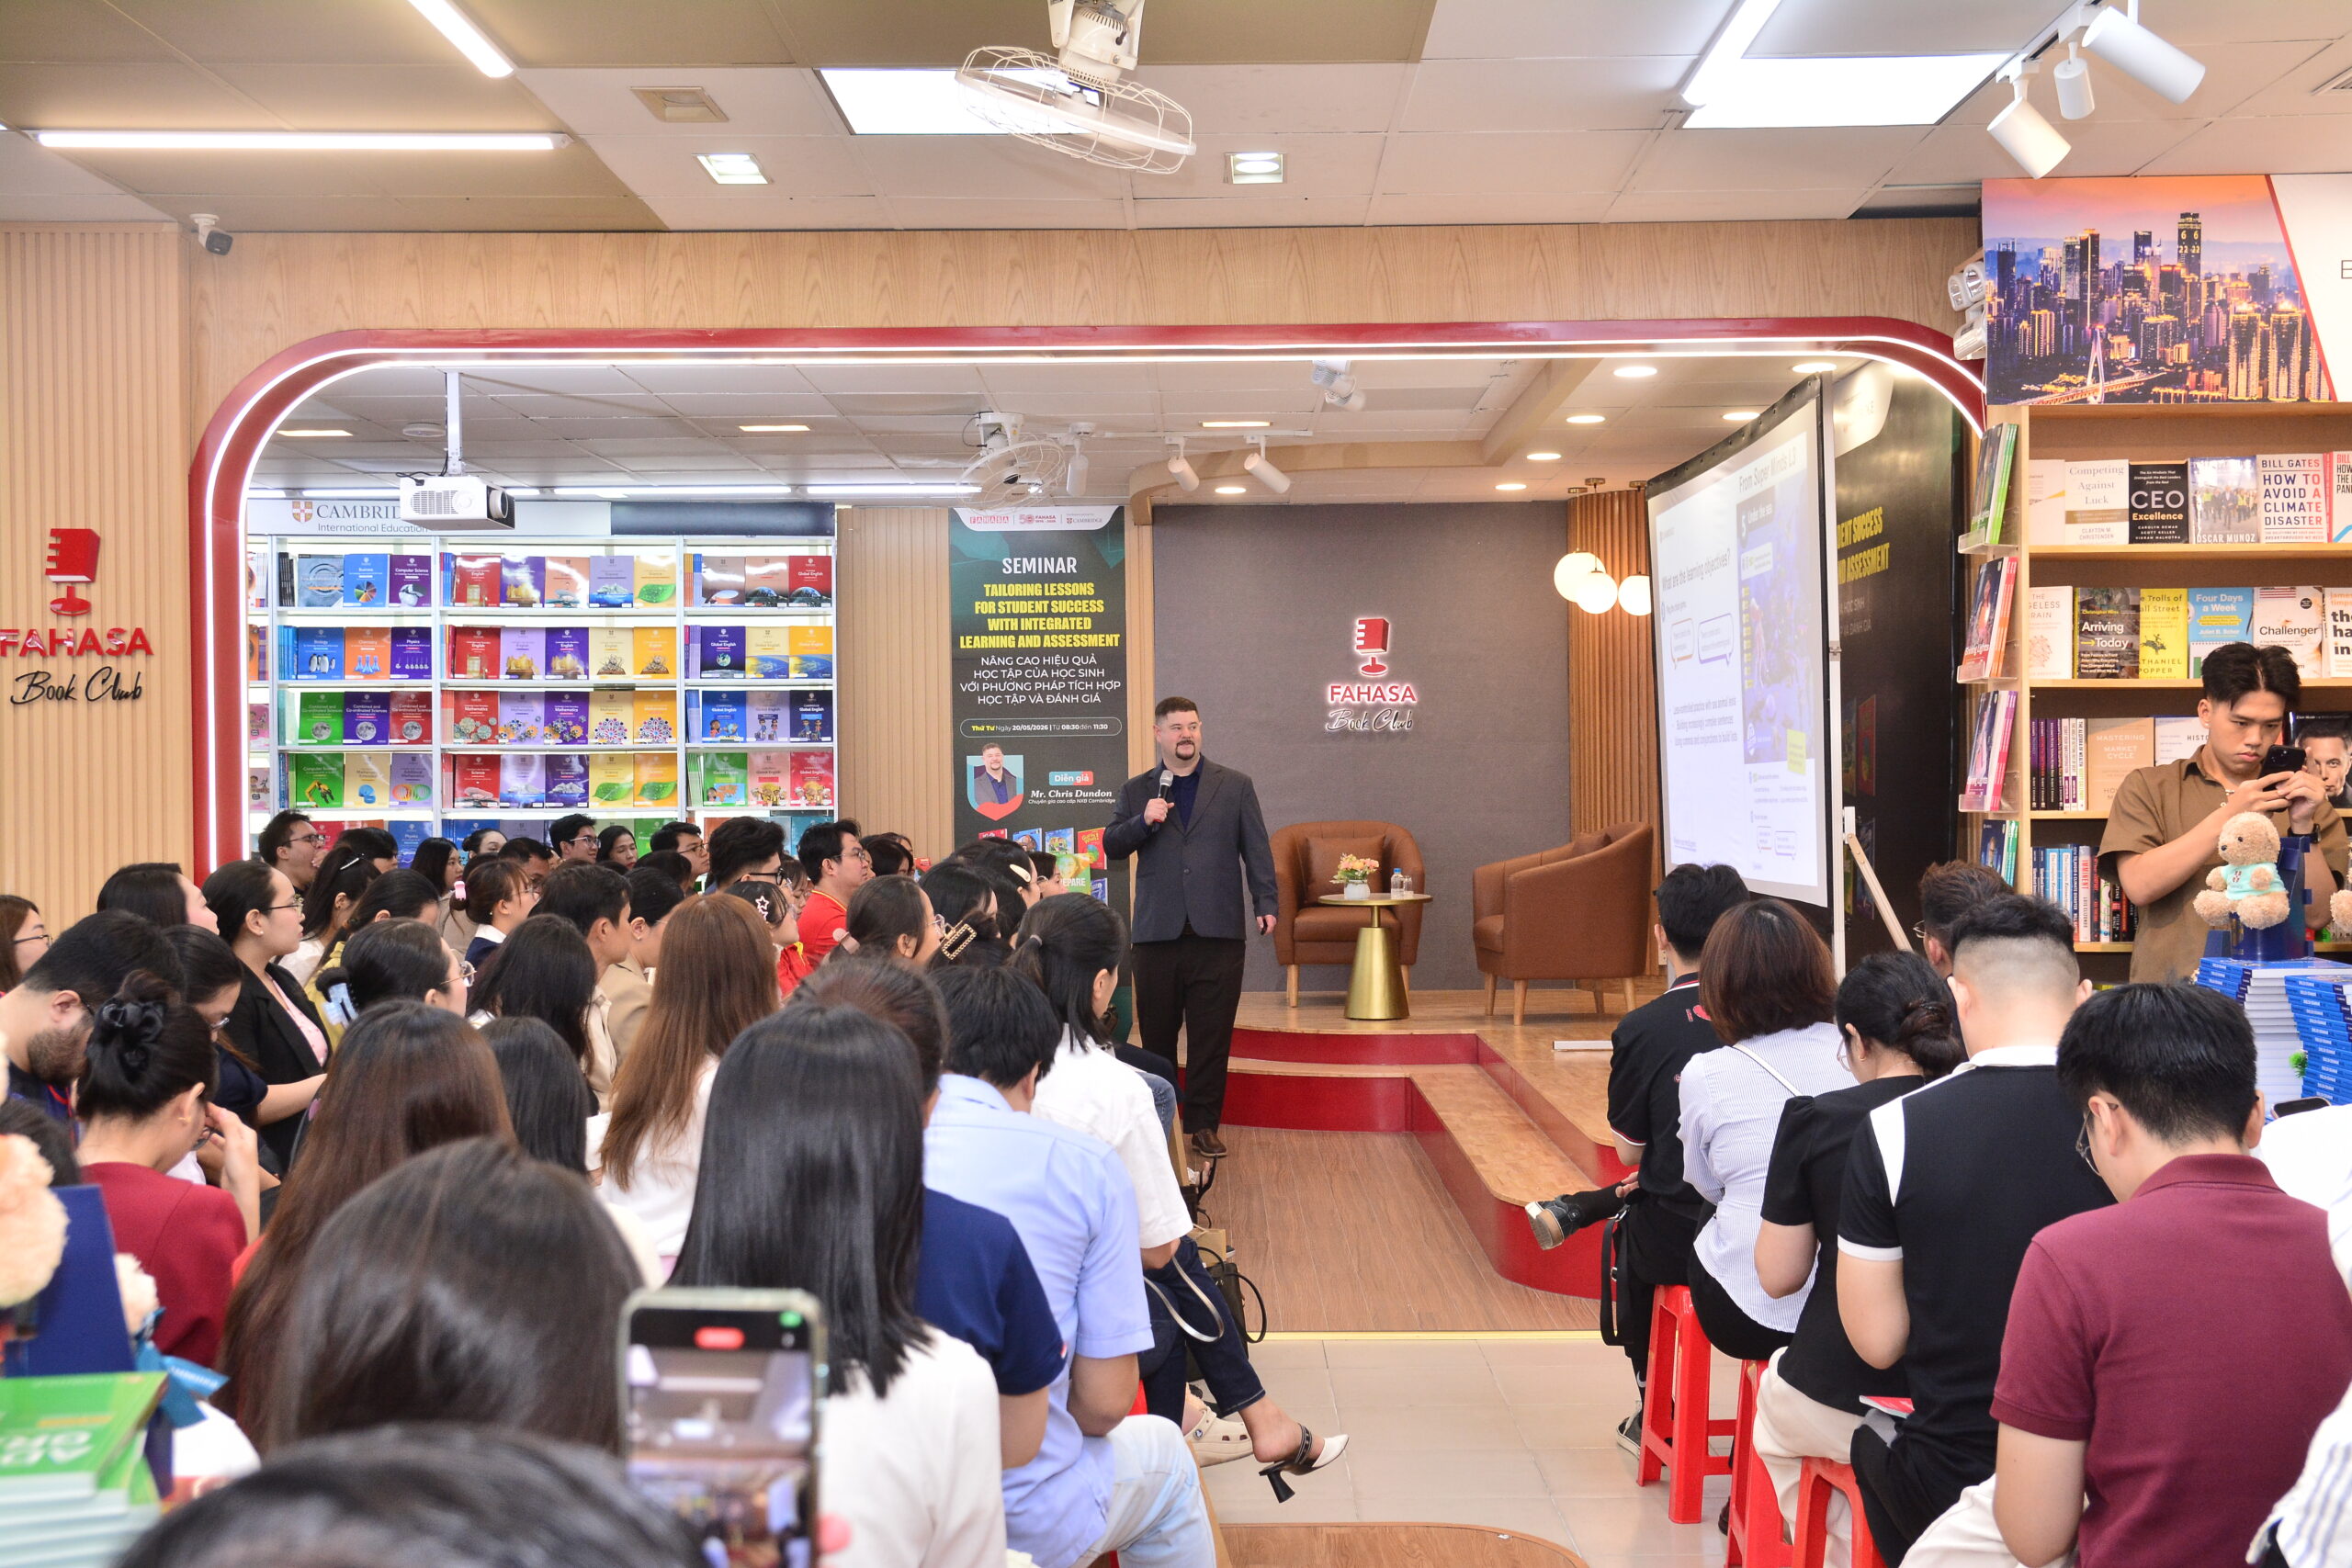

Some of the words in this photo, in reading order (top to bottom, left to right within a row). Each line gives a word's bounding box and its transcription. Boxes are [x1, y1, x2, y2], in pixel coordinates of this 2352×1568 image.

[2261, 459, 2284, 468] BILL
[2288, 459, 2320, 468] GATES
[2336, 454, 2350, 463] BILL
[2069, 466, 2124, 477] Competing
[2263, 474, 2296, 486] HOW
[2302, 473, 2321, 485] TO
[2336, 475, 2348, 483] THE
[2078, 481, 2115, 491] Against
[2336, 485, 2352, 493] PAN
[2264, 488, 2306, 499] AVOID
[2312, 488, 2321, 499] A
[2085, 496, 2109, 504] Luck
[2131, 491, 2185, 509] CEO
[2264, 502, 2322, 513] CLIMATE
[2132, 512, 2184, 521] Excellence
[2265, 516, 2323, 525] DISASTER
[318, 524, 379, 533] International
[381, 524, 428, 533] Education
[1852, 506, 1883, 544] SUCCESS
[2197, 534, 2223, 543] OSCAR
[2226, 534, 2256, 543] MUNOZ
[1002, 557, 1077, 574] SEMINAR
[984, 583, 1042, 597] TAILORING
[1044, 582, 1094, 596] LESSONS
[2220, 593, 2244, 603] Days
[975, 602, 996, 615] FOR
[998, 601, 1049, 614] STUDENT
[1051, 600, 1104, 613] SUCCESS
[2211, 604, 2236, 612] Week
[2331, 610, 2352, 623] th
[988, 618, 1018, 631] WITH
[1021, 617, 1092, 630] INTEGRATED
[2082, 621, 2124, 634] Arriving
[2259, 626, 2318, 637] Challenger
[0, 627, 154, 657] FAHASA
[960, 636, 1016, 649] LEARNING
[1018, 635, 1041, 648] AND
[1043, 634, 1120, 647] ASSESSMENT
[2095, 637, 2129, 649] Today
[981, 656, 1013, 666] NÂNG
[1015, 656, 1040, 665] CAO
[1043, 654, 1069, 667] HIỆU
[1071, 653, 1097, 667] QUẢ
[973, 670, 999, 681] HỌC
[1001, 668, 1023, 681] TẬP
[1024, 667, 1048, 679] CỦA
[1051, 669, 1076, 680] HỌC
[1078, 668, 1105, 678] SINH
[10, 671, 77, 705] Book
[85, 666, 142, 702] Club
[959, 681, 979, 693] VỚI
[982, 682, 1032, 692] PHƯƠNG
[1035, 680, 1066, 691] PHÁP
[1068, 680, 1093, 691] TÍCH
[1096, 679, 1121, 693] HỢP
[978, 695, 1002, 706] HỌC
[1004, 693, 1026, 706] TẬP
[1028, 693, 1044, 704] VÀ
[1046, 692, 1079, 704] ĐÁNH
[1081, 692, 1102, 703] GIÁ
[1329, 684, 1417, 703] FAHASA
[1326, 708, 1370, 731] Book
[1373, 708, 1413, 731] Club
[996, 724, 1011, 732] Ngày
[1055, 773, 1074, 782] Diễn
[1076, 773, 1089, 784] giả
[1031, 790, 1046, 798] Mr.
[1048, 790, 1073, 798] Chris
[1075, 789, 1113, 798] Dundon
[2081, 860, 2089, 889] IMMINENT
[1061, 877, 1086, 887] EPARE
